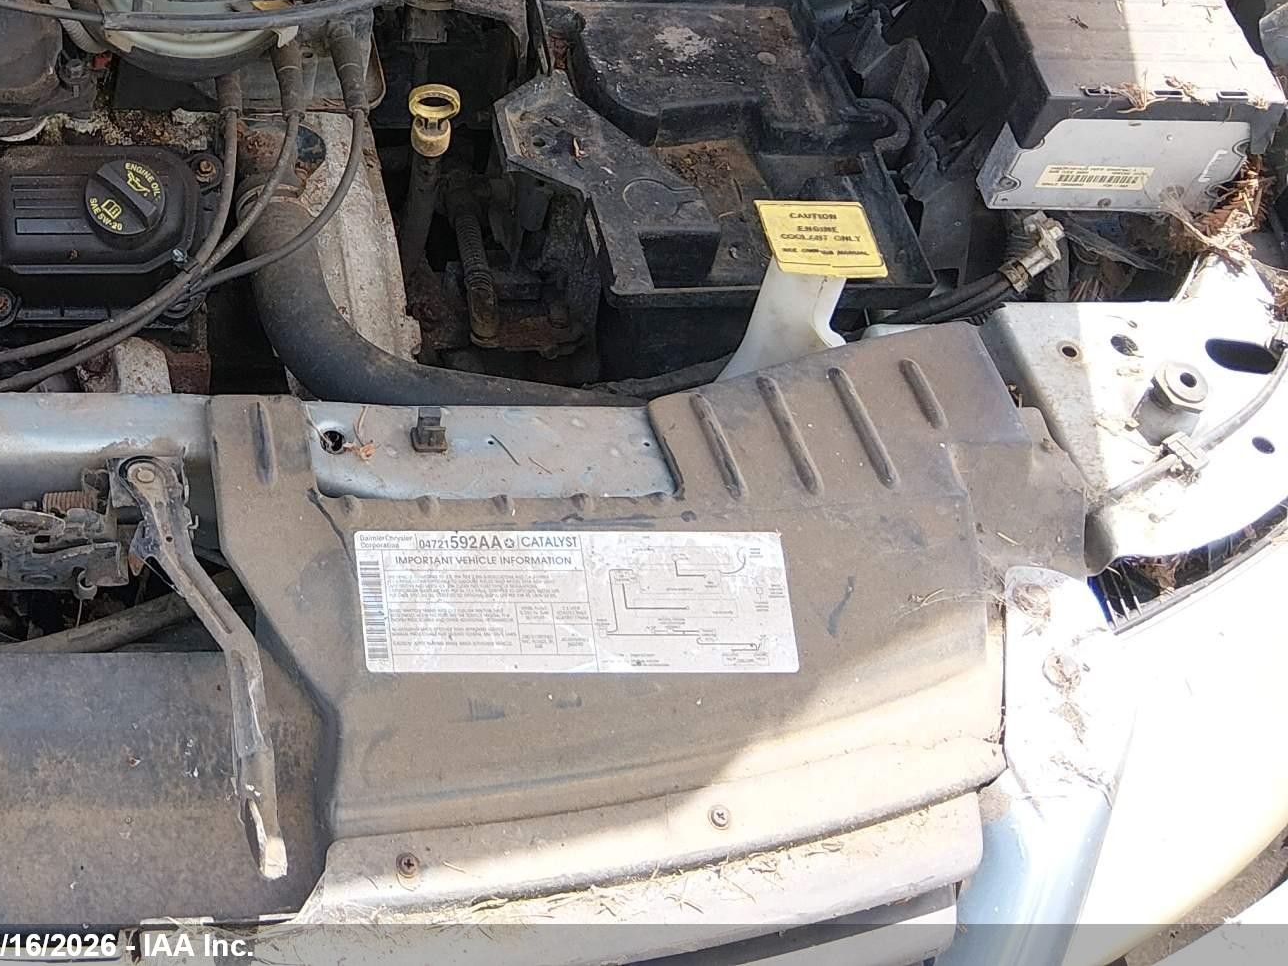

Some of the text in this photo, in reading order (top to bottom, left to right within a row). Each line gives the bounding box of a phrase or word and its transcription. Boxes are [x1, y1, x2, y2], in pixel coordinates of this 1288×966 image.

[125, 162, 161, 197] ENGINE OIL
[90, 198, 123, 231] SAE 5W-20
[419, 535, 503, 549] 04721592AA
[521, 537, 578, 548] CATALYST
[395, 555, 572, 565] IMPORTANT VEHICLE INFORMATION
